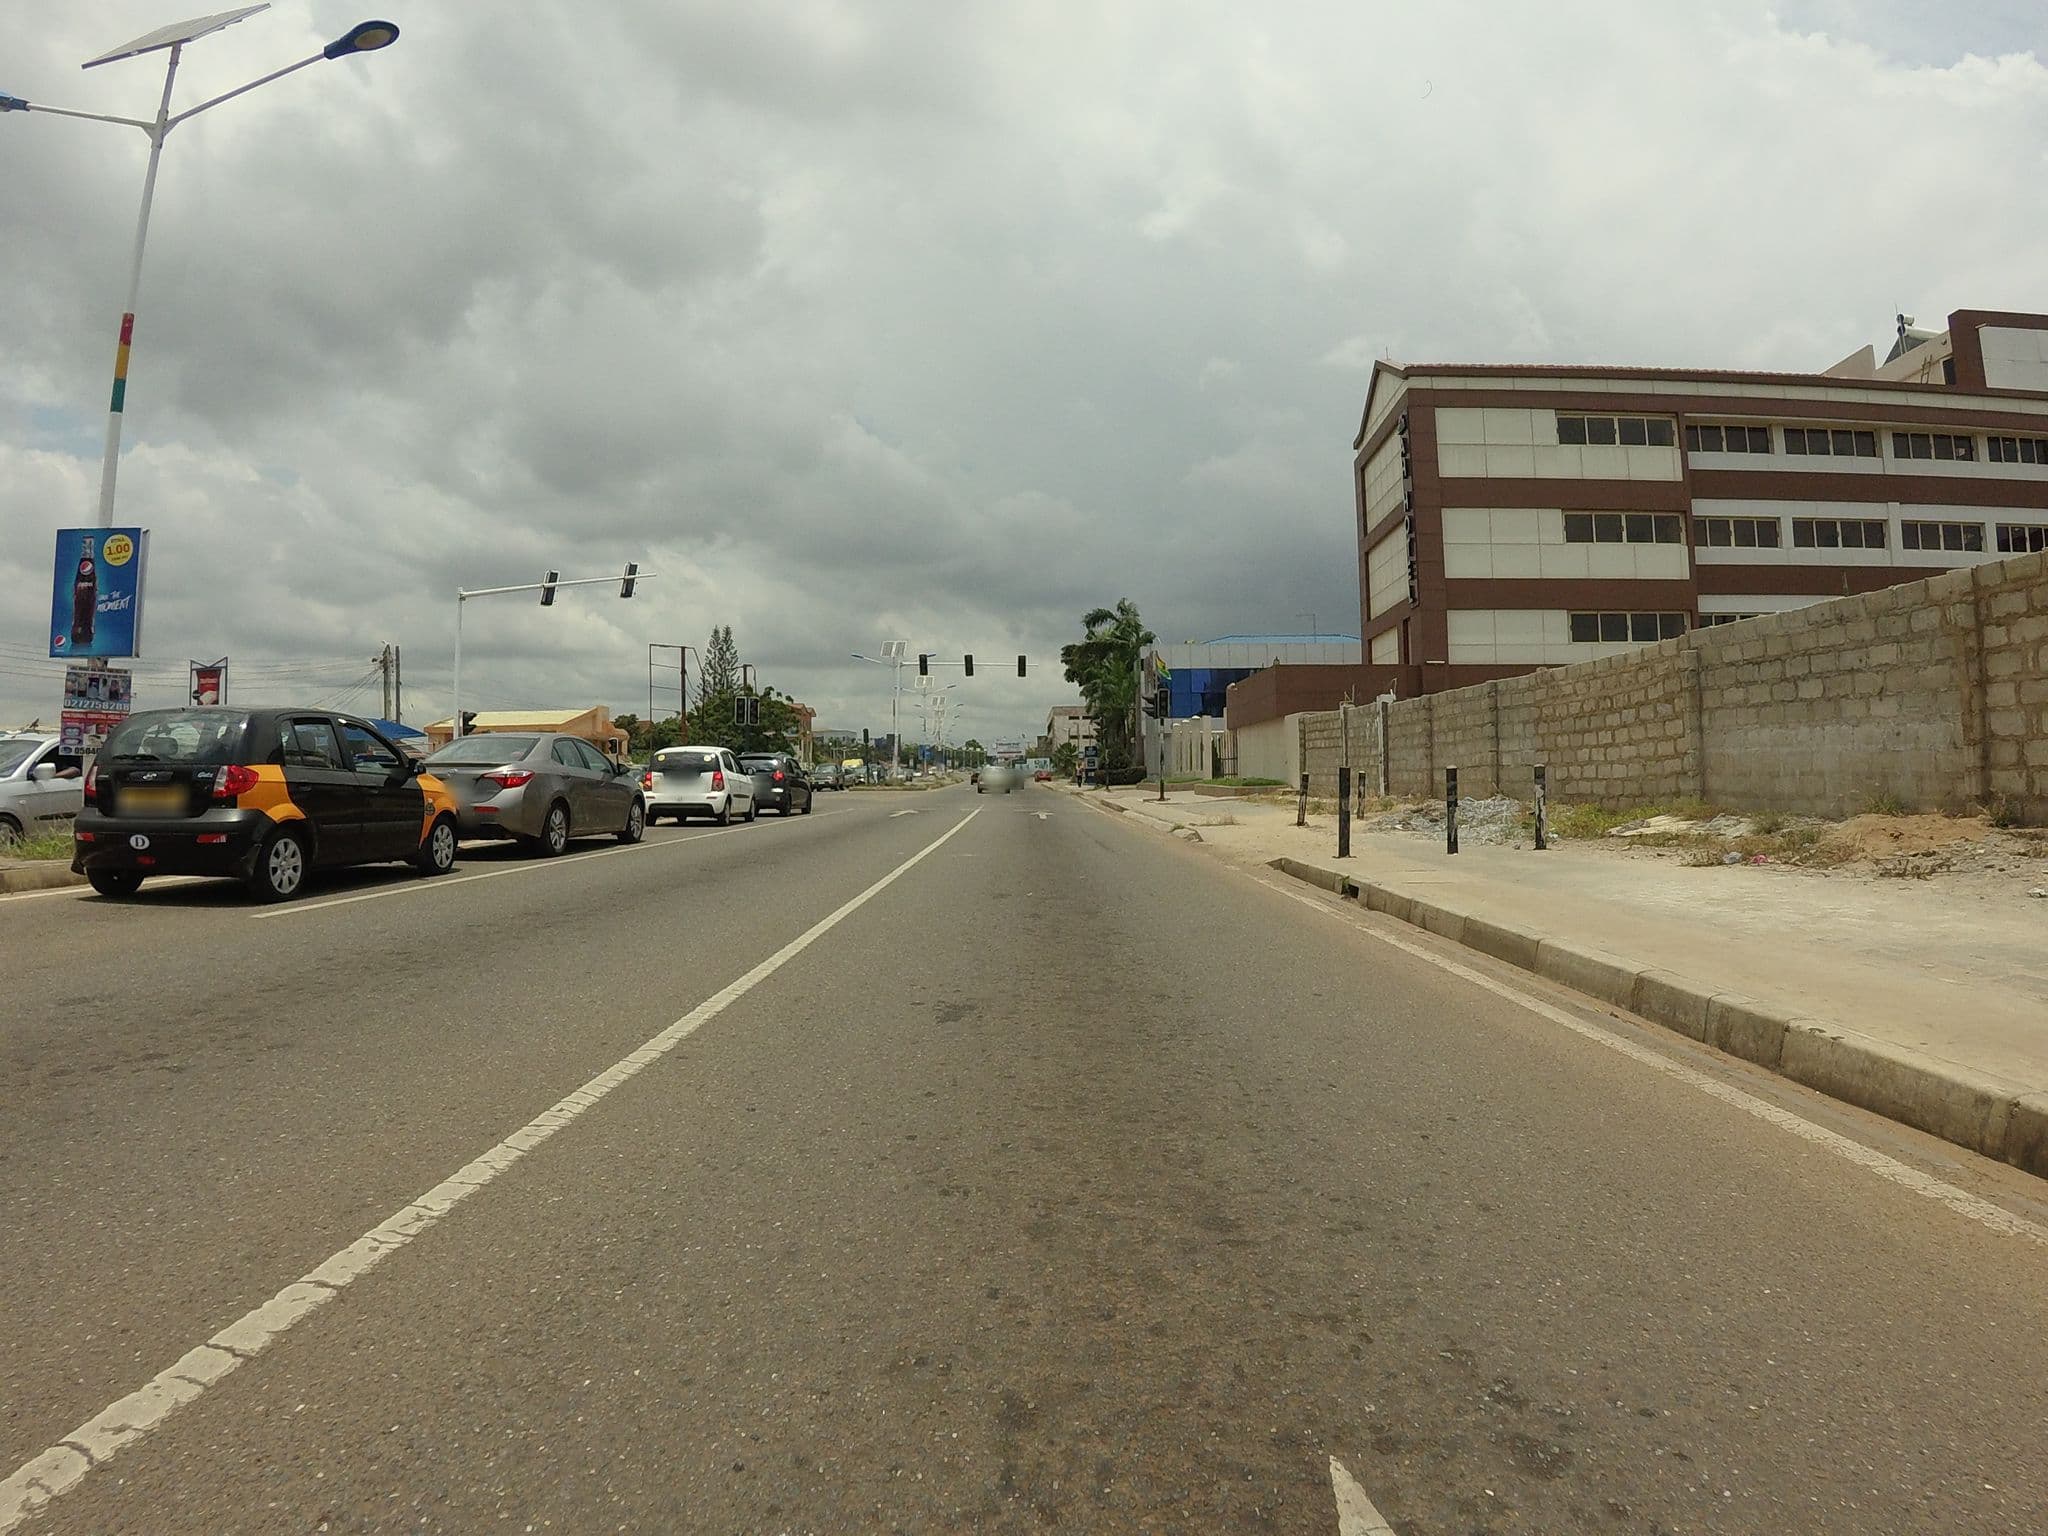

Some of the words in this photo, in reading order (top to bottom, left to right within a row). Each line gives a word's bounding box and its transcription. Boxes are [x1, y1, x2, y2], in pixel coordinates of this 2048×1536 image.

[106, 542, 130, 556] 1.00
[1403, 490, 1419, 609] HOTEL
[135, 836, 145, 848] D
